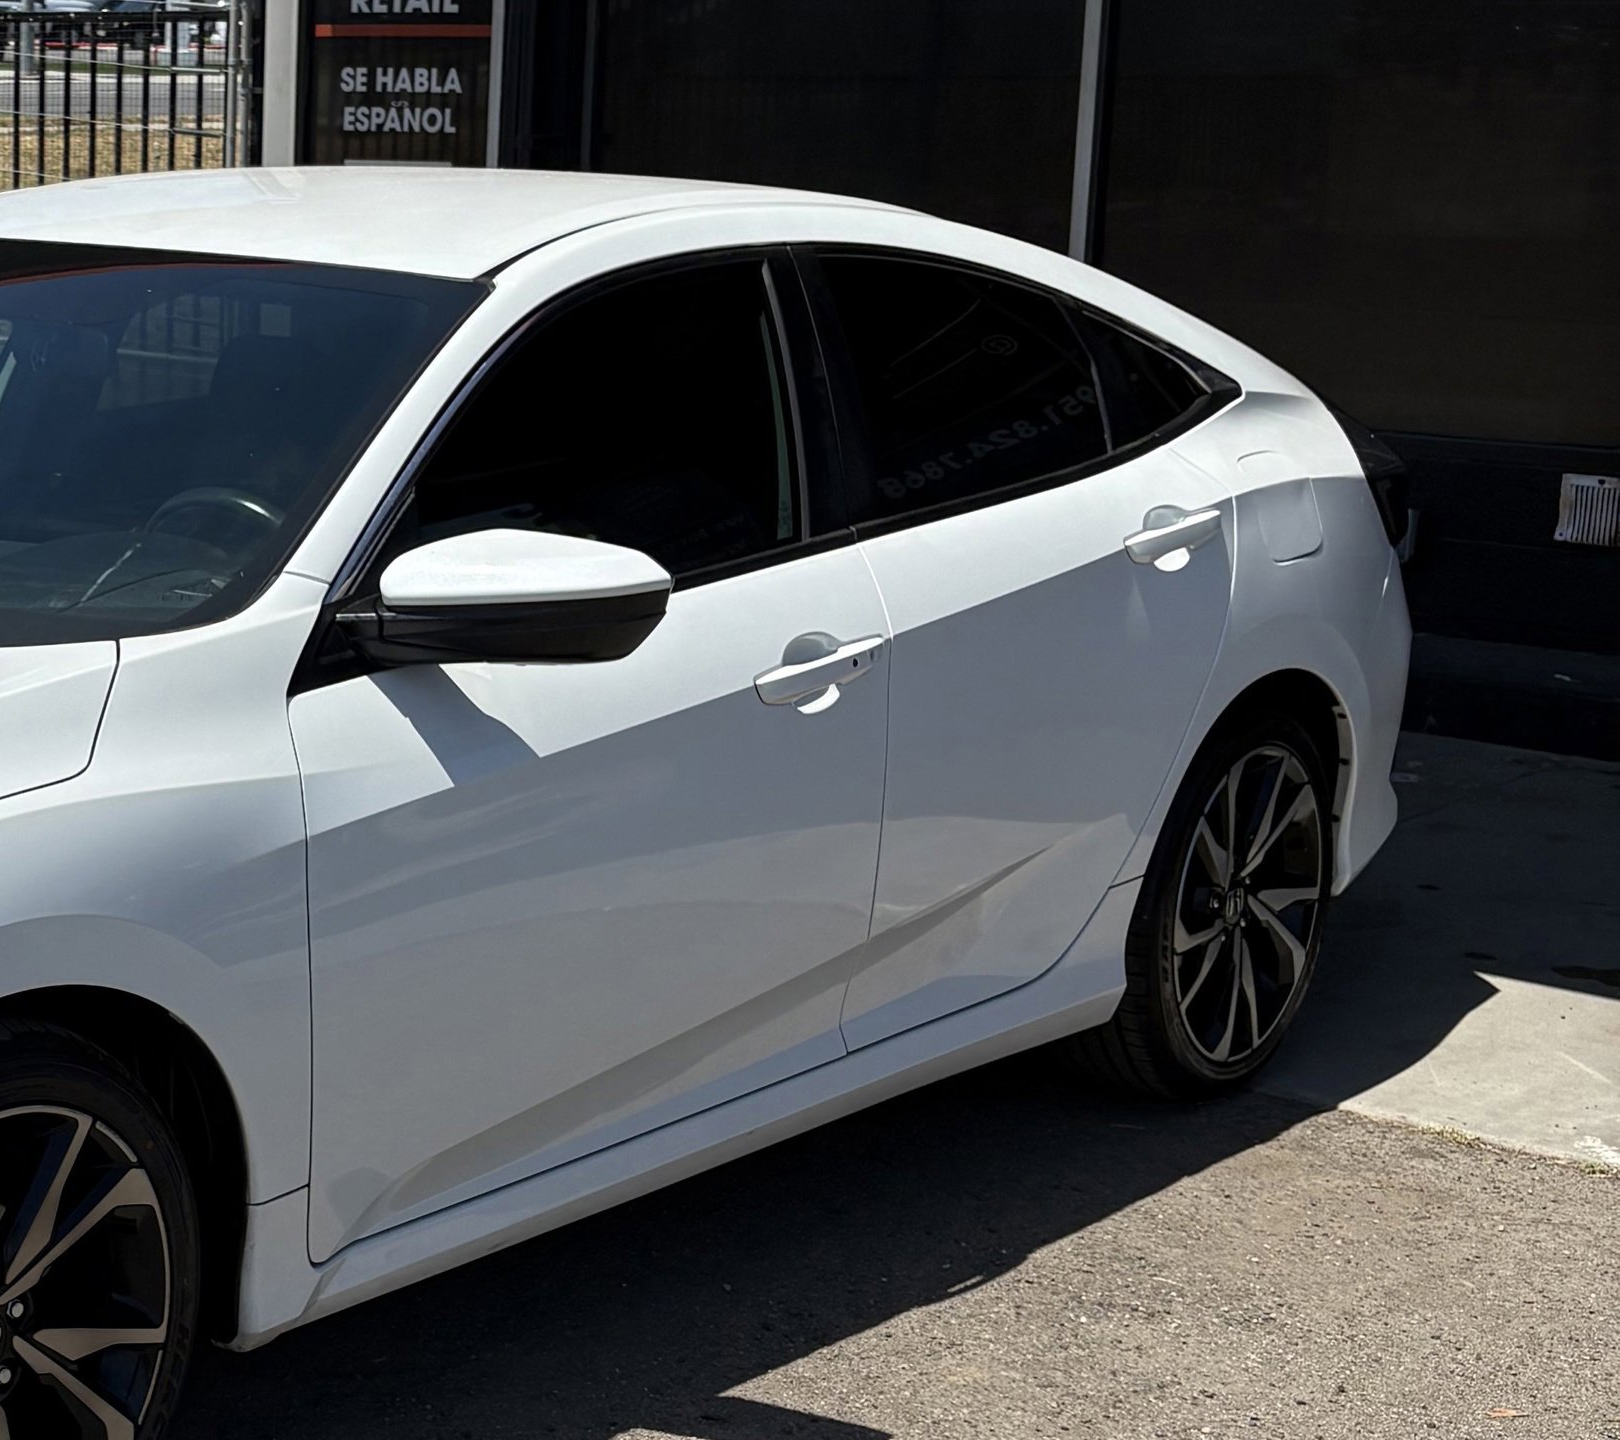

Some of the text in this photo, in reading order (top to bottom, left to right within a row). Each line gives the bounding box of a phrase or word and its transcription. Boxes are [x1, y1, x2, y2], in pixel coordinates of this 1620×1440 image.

[340, 67, 462, 94] SE HABLA
[342, 100, 457, 134] ESPAÑOL
